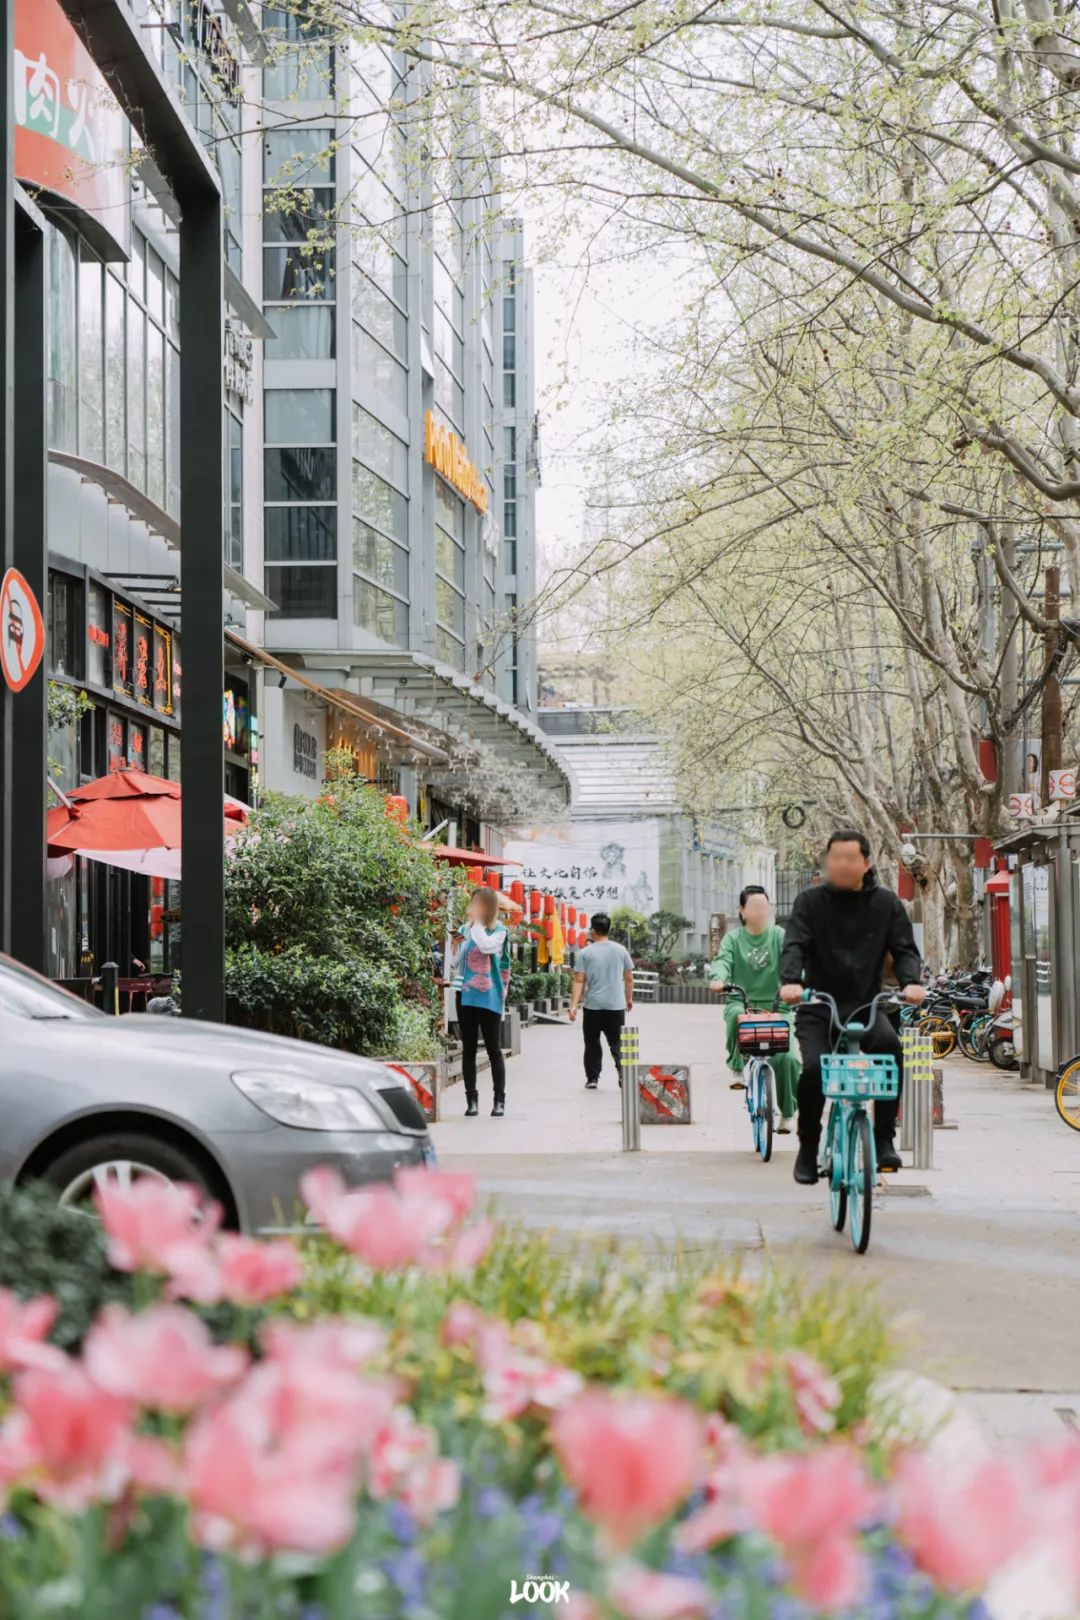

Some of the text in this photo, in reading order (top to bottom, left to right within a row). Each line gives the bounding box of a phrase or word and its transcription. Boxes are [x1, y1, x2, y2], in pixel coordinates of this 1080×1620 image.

[523, 866, 598, 880] 让文化自信
